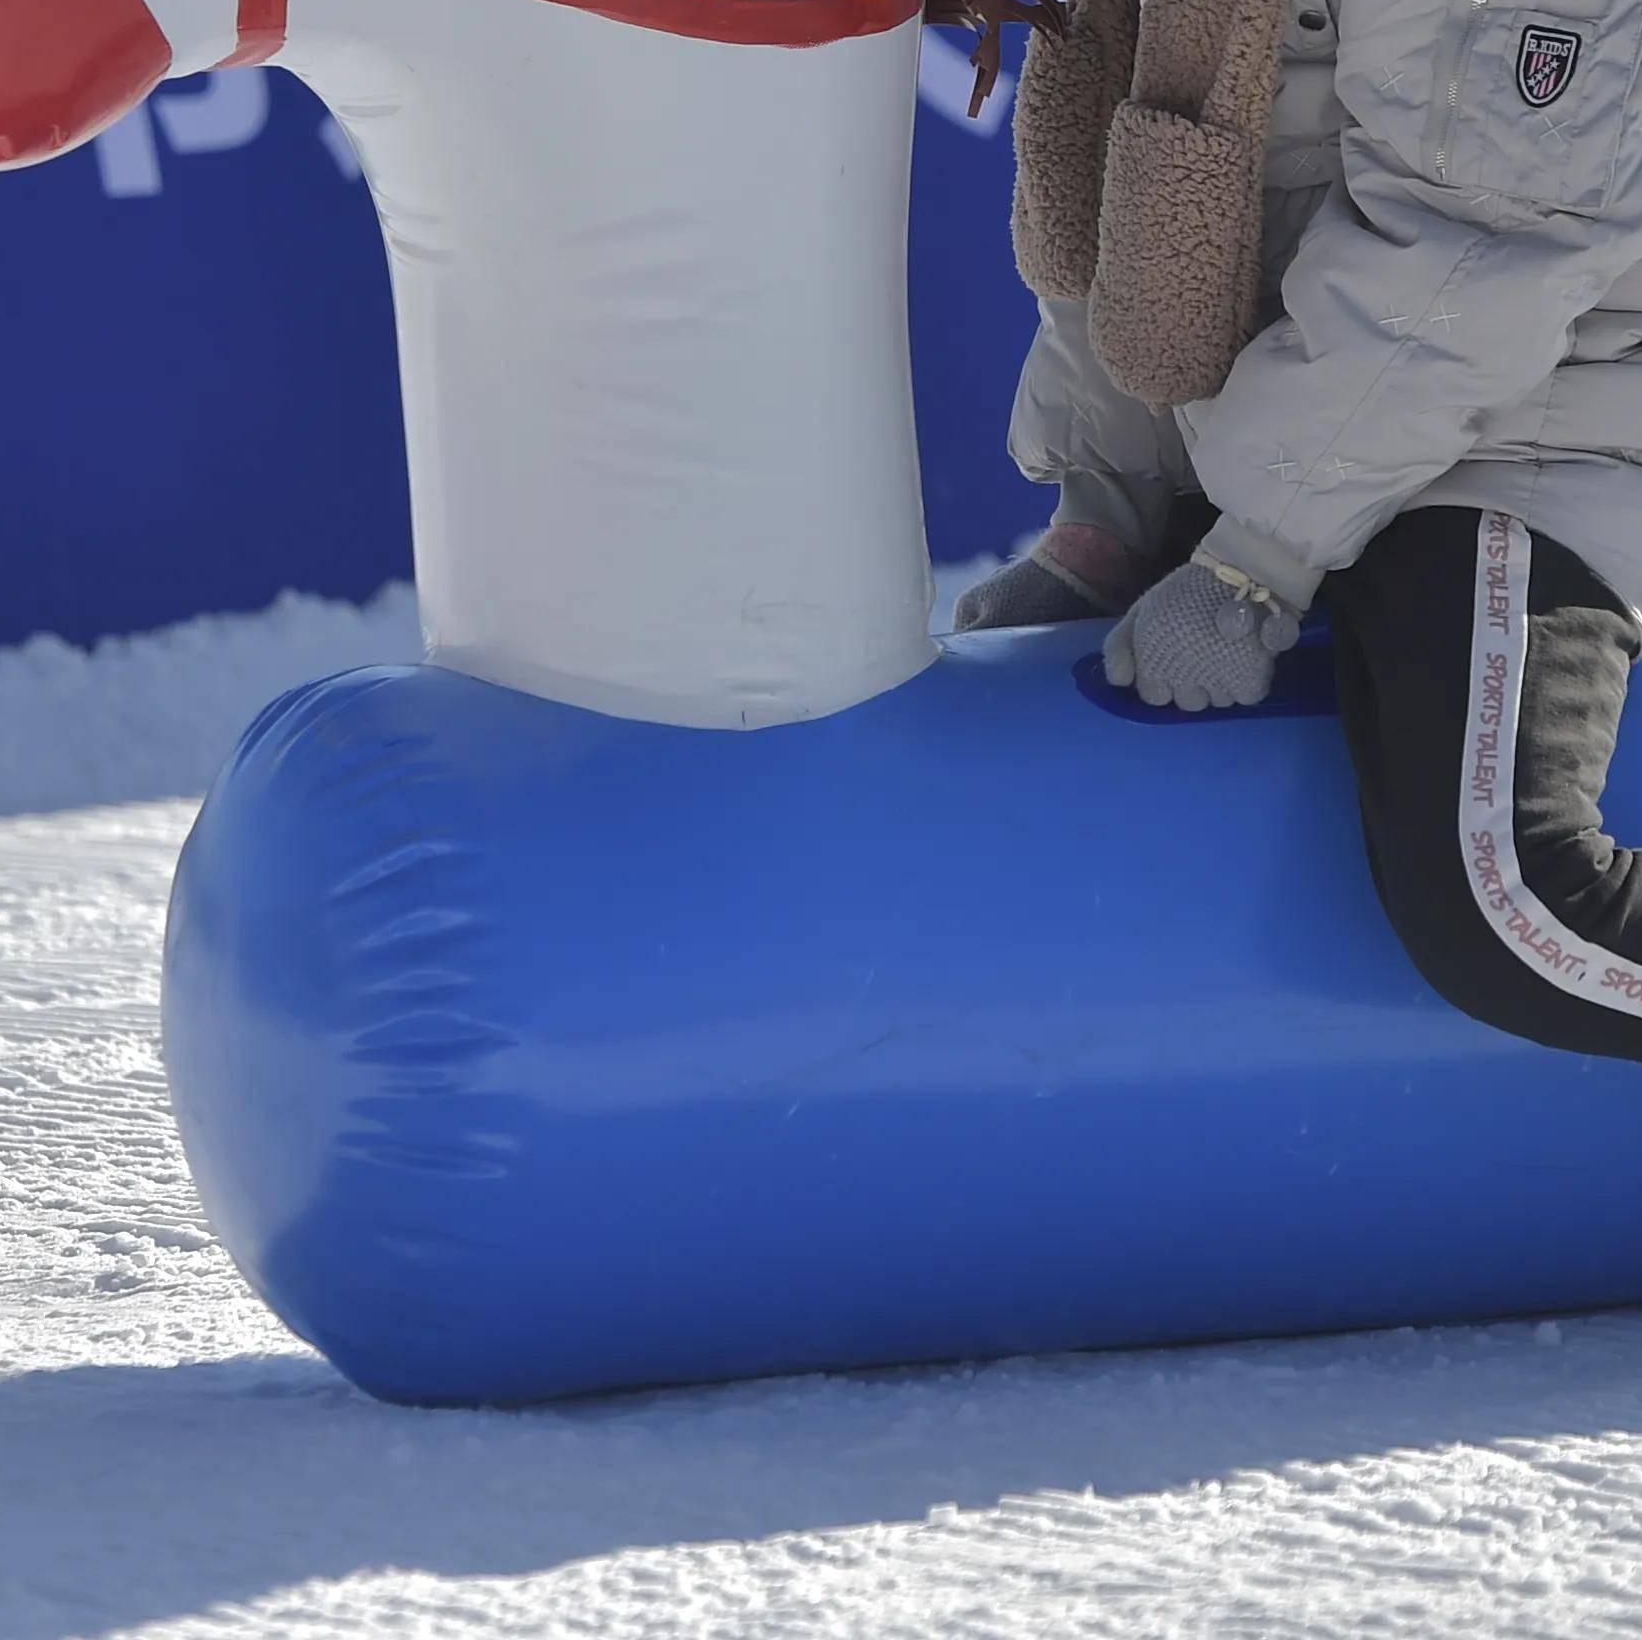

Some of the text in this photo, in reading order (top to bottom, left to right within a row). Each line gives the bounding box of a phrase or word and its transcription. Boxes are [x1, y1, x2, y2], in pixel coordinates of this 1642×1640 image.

[1486, 563, 1510, 635] TALENT
[1471, 652, 1507, 808] SPORTS TALENT
[1470, 830, 1587, 973] SPORTS TALENT
